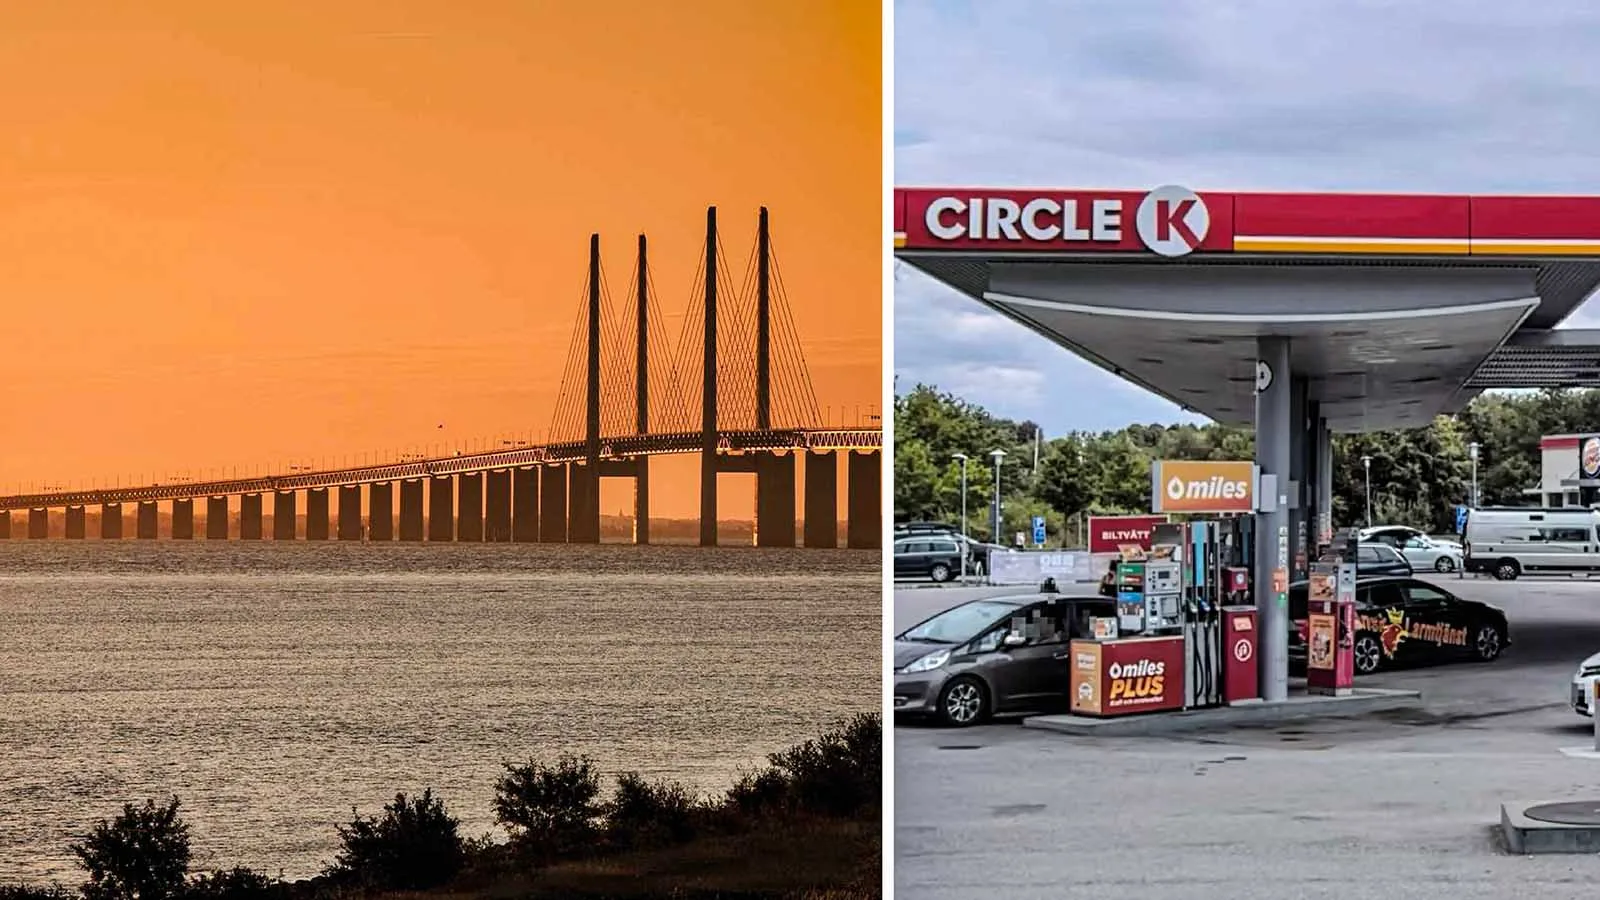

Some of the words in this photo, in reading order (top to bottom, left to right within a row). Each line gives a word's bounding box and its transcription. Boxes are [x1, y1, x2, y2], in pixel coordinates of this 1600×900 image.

[925, 196, 1123, 242] CIRCLE
[1156, 199, 1202, 251] K
[1185, 476, 1248, 499] miles
[1122, 659, 1165, 678] miles
[1109, 675, 1165, 699] PLUS
